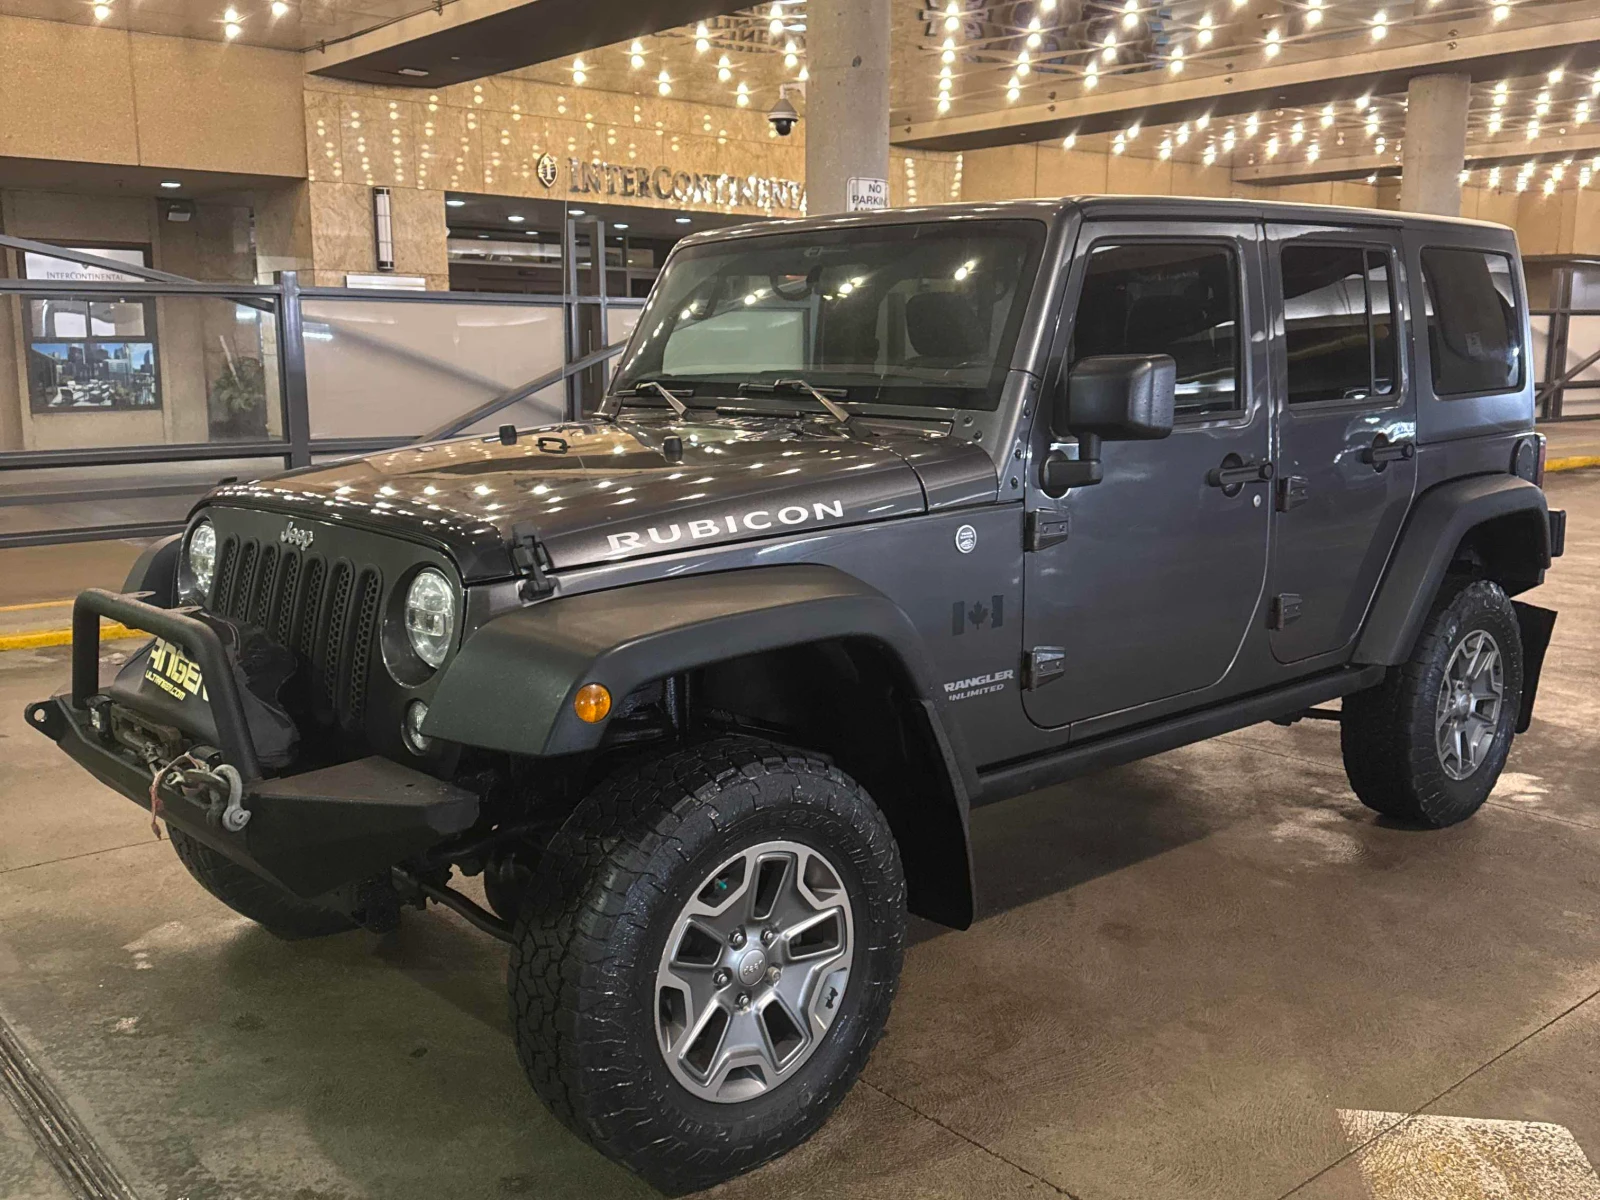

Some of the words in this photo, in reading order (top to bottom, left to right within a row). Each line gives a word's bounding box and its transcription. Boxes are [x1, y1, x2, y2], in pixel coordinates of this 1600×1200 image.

[868, 183, 882, 194] NO
[280, 521, 314, 551] Jeep
[606, 500, 844, 551] RUBICON
